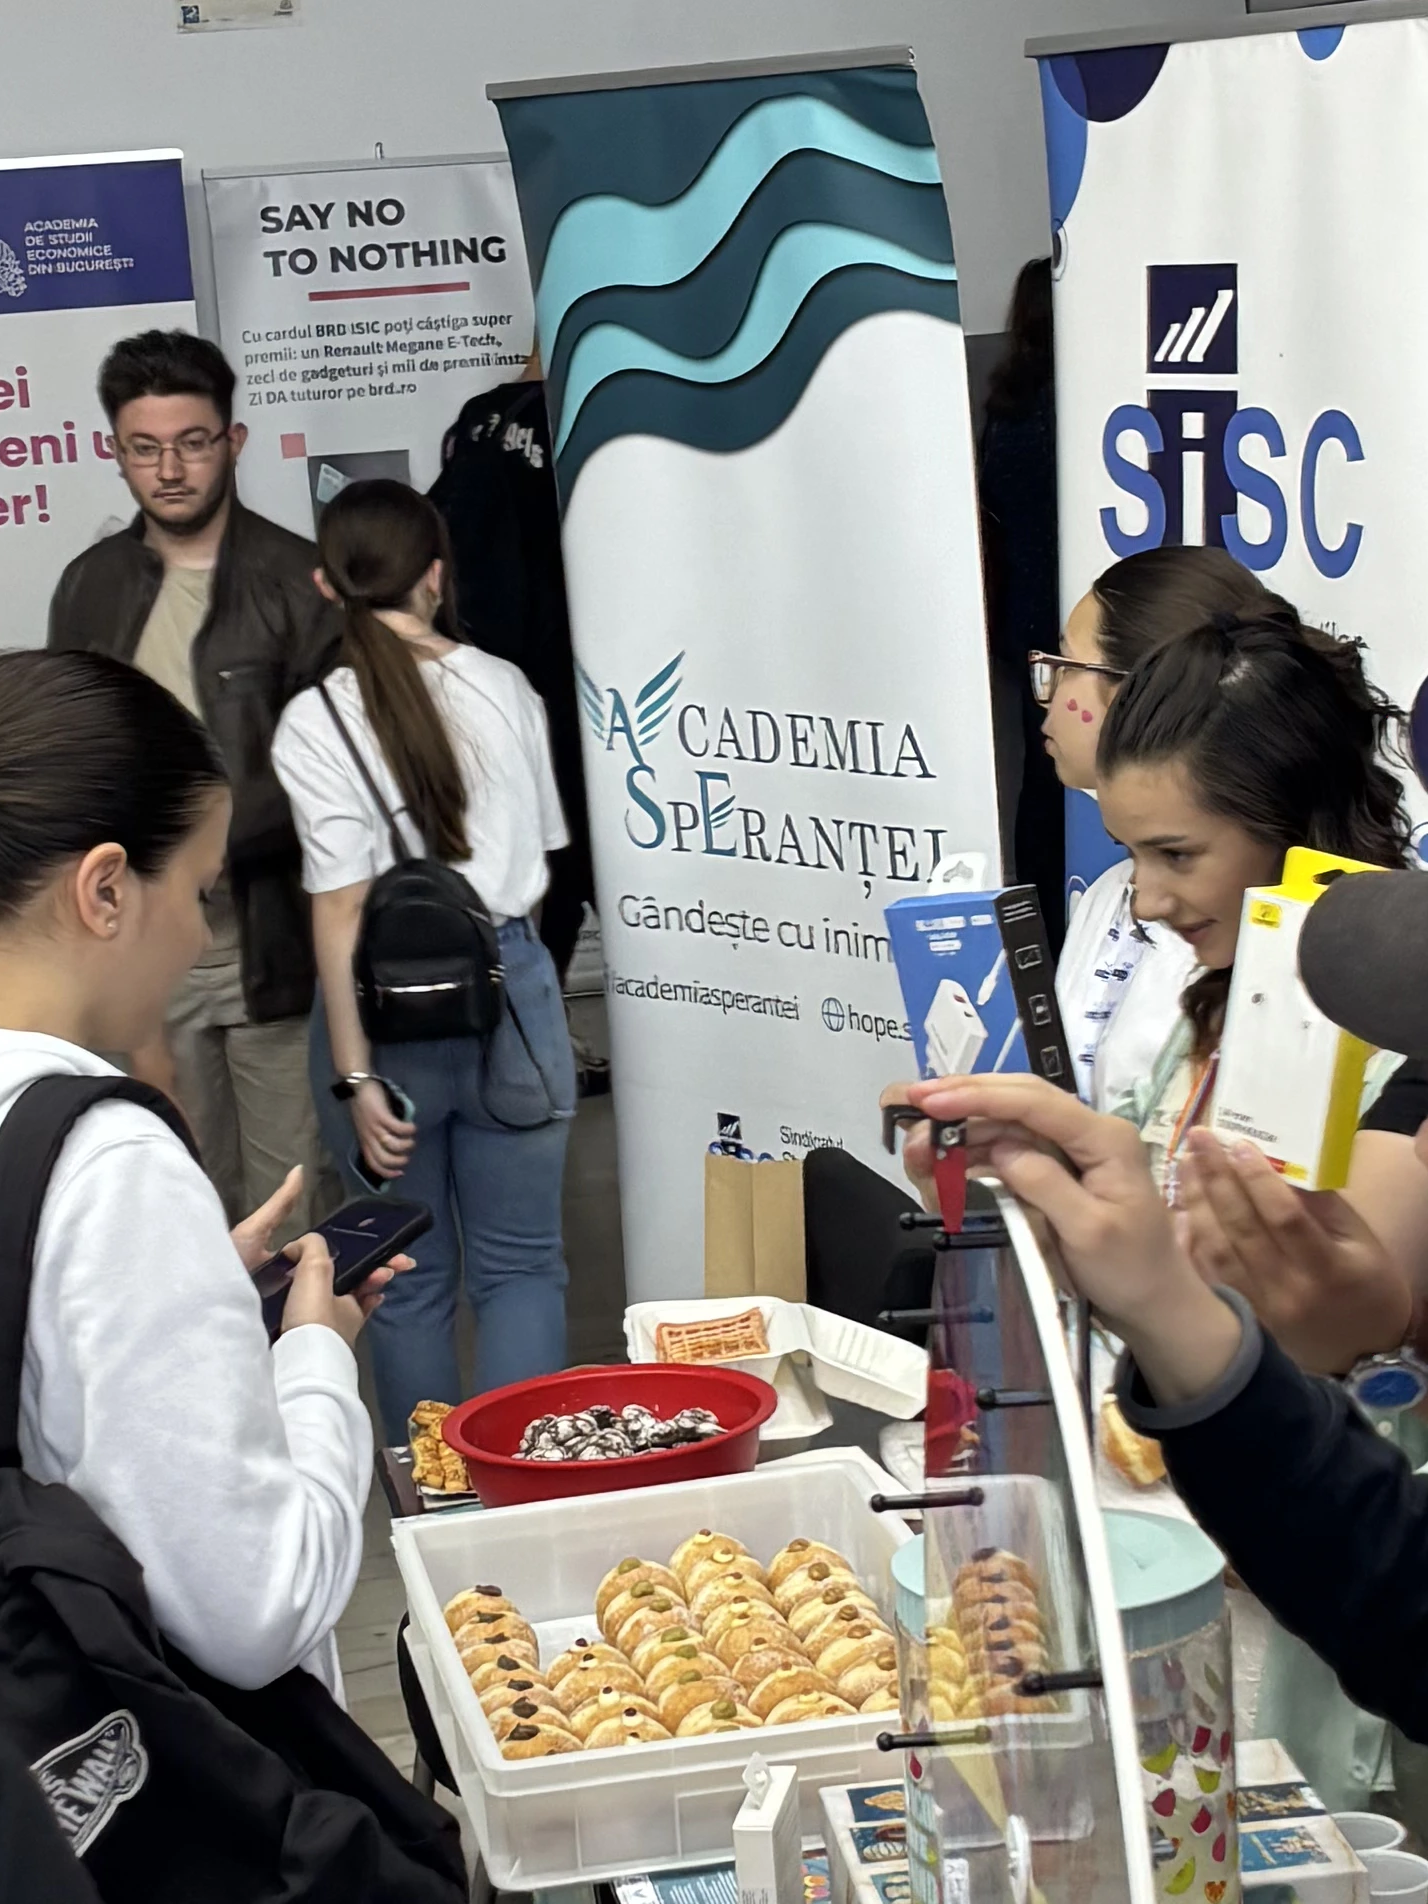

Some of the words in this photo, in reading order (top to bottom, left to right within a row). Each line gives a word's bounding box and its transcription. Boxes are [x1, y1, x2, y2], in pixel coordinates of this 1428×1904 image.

[24, 217, 99, 233] ACADEMIA
[260, 202, 336, 234] SAY
[347, 198, 406, 228] NO
[25, 234, 45, 246] DE
[49, 232, 93, 245] STUDII
[26, 245, 113, 261] ECONOMICE
[28, 262, 53, 276] DIN
[263, 248, 318, 277] TO
[329, 235, 507, 273] NOTHING
[241, 329, 262, 345] Cu
[265, 324, 313, 342] cardul
[316, 320, 347, 337] BRD
[350, 320, 381, 336] ISIC
[471, 312, 514, 329] super
[244, 346, 299, 367] premii:
[301, 347, 320, 360] un
[323, 339, 384, 358] Renault
[386, 338, 445, 356] Megane
[246, 369, 275, 386] zeci
[278, 367, 298, 383] de
[301, 362, 375, 384] gadgeturi
[265, 388, 288, 405] DA
[291, 385, 344, 403] tuturor
[347, 386, 366, 402] pe
[605, 687, 937, 780] ACADEMIA
[618, 894, 770, 951] Gândește
[777, 920, 815, 950] cu
[822, 916, 894, 963] inim
[848, 1002, 913, 1043] hope.s
